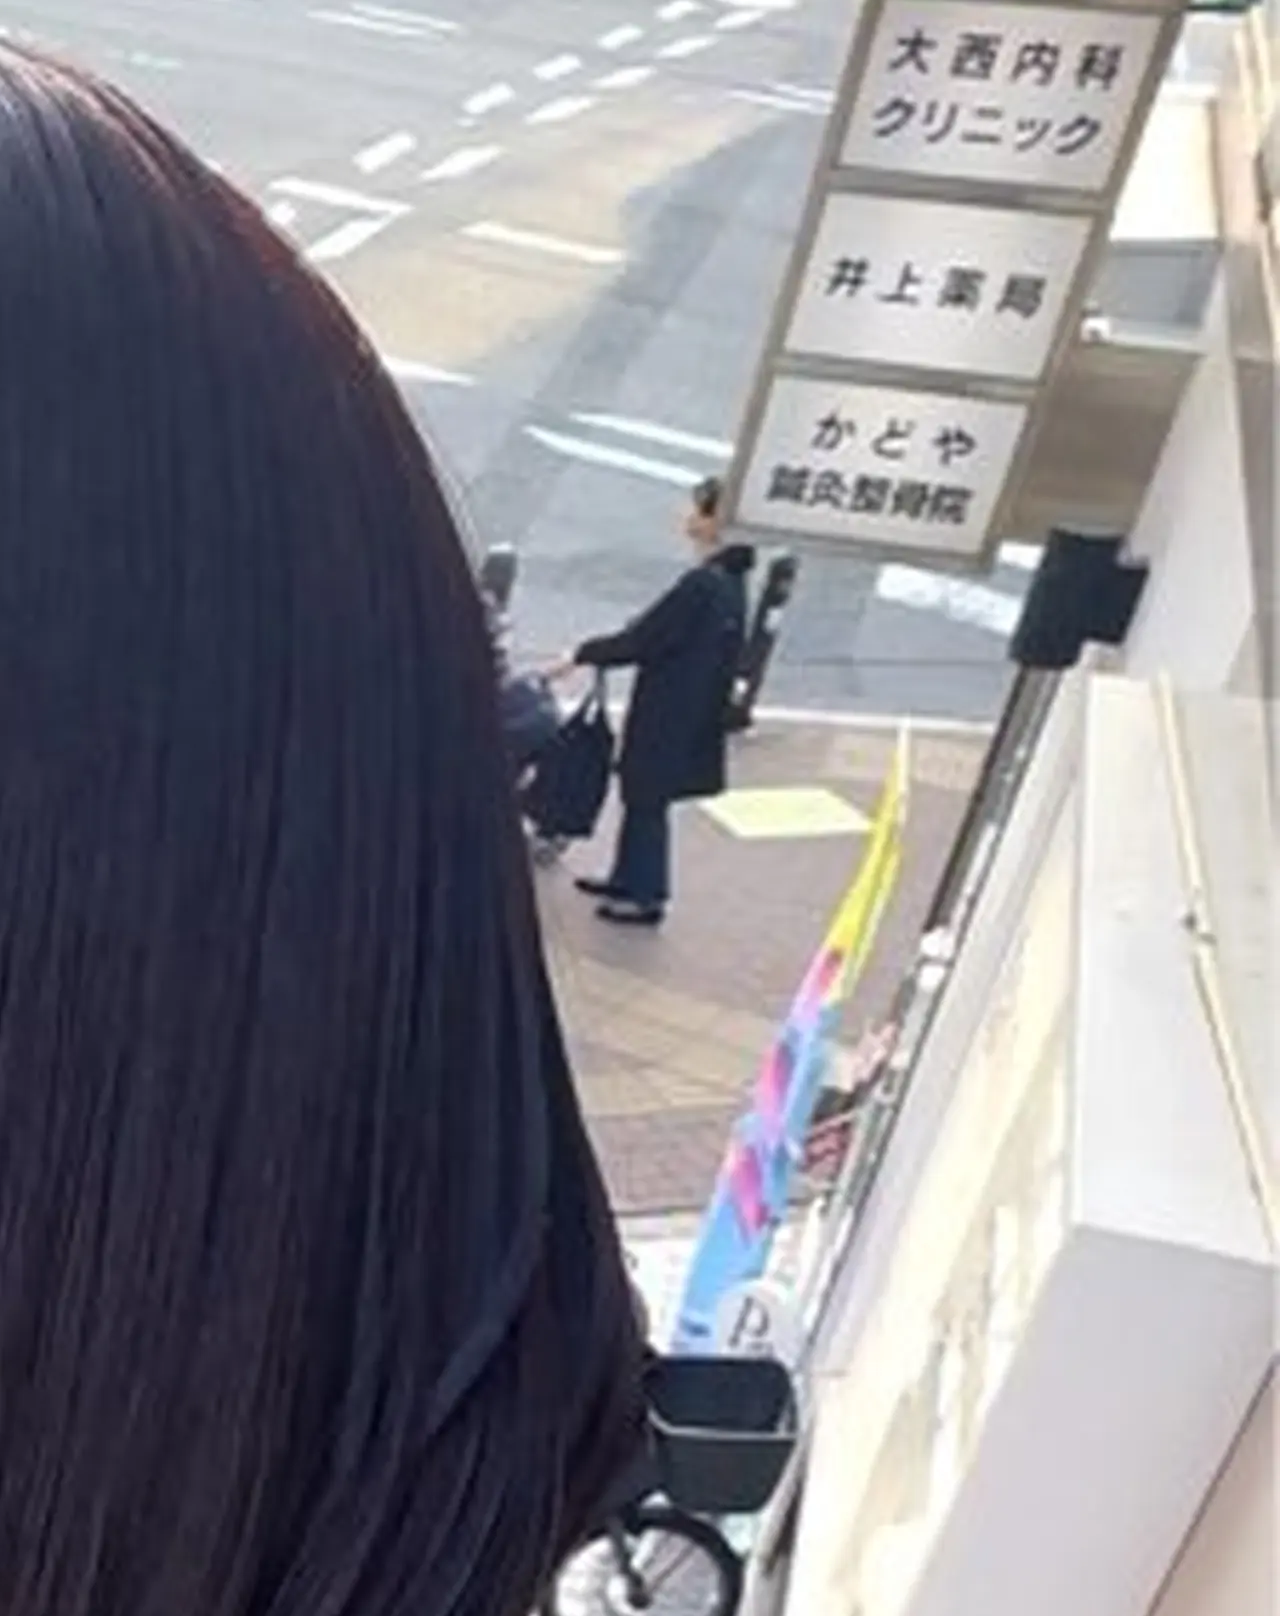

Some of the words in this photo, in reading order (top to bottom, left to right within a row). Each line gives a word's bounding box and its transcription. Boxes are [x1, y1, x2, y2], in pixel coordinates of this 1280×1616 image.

[889, 29, 1126, 90] 大西内科
[873, 96, 1103, 156] クリニック
[826, 256, 1048, 320] 井上薬局
[811, 410, 978, 466] かどや
